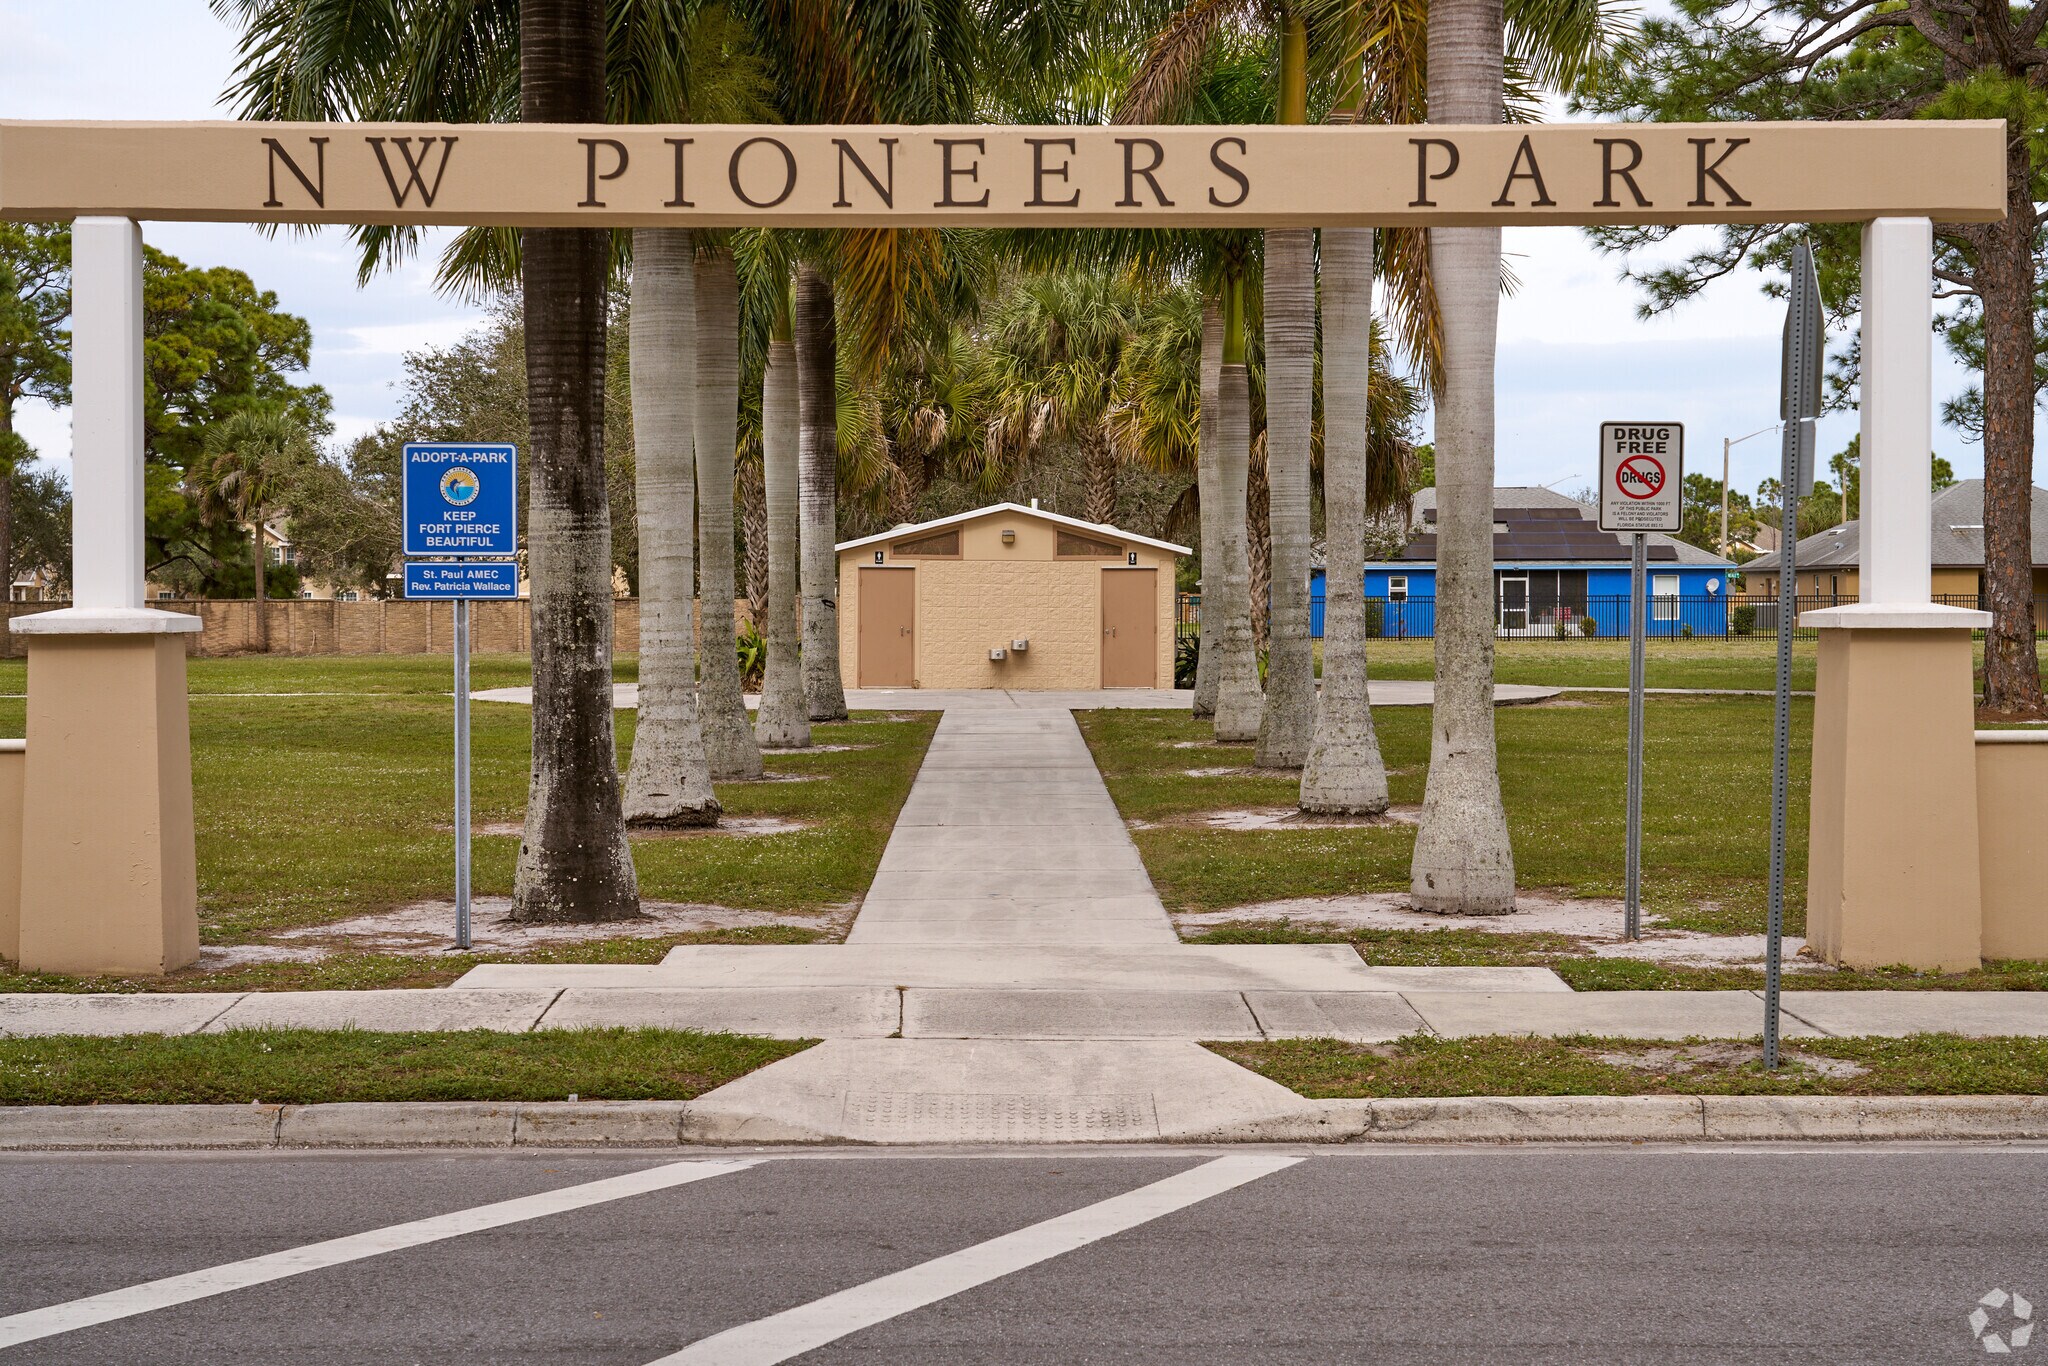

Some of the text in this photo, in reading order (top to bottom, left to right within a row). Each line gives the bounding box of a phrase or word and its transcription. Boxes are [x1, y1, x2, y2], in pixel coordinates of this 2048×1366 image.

[261, 134, 1752, 208] NW PIONEERS PARK
[1614, 428, 1670, 440] DRUG
[1616, 441, 1667, 454] FREE
[411, 452, 508, 463] ADOPT-A-PARK
[443, 511, 477, 521] KEEP
[419, 524, 500, 534] FORT PIERCE
[426, 537, 494, 547] BEAUTIFUL
[423, 570, 499, 579] St. Paul AMEC
[411, 582, 511, 591] Rev. Patricia Wallace
